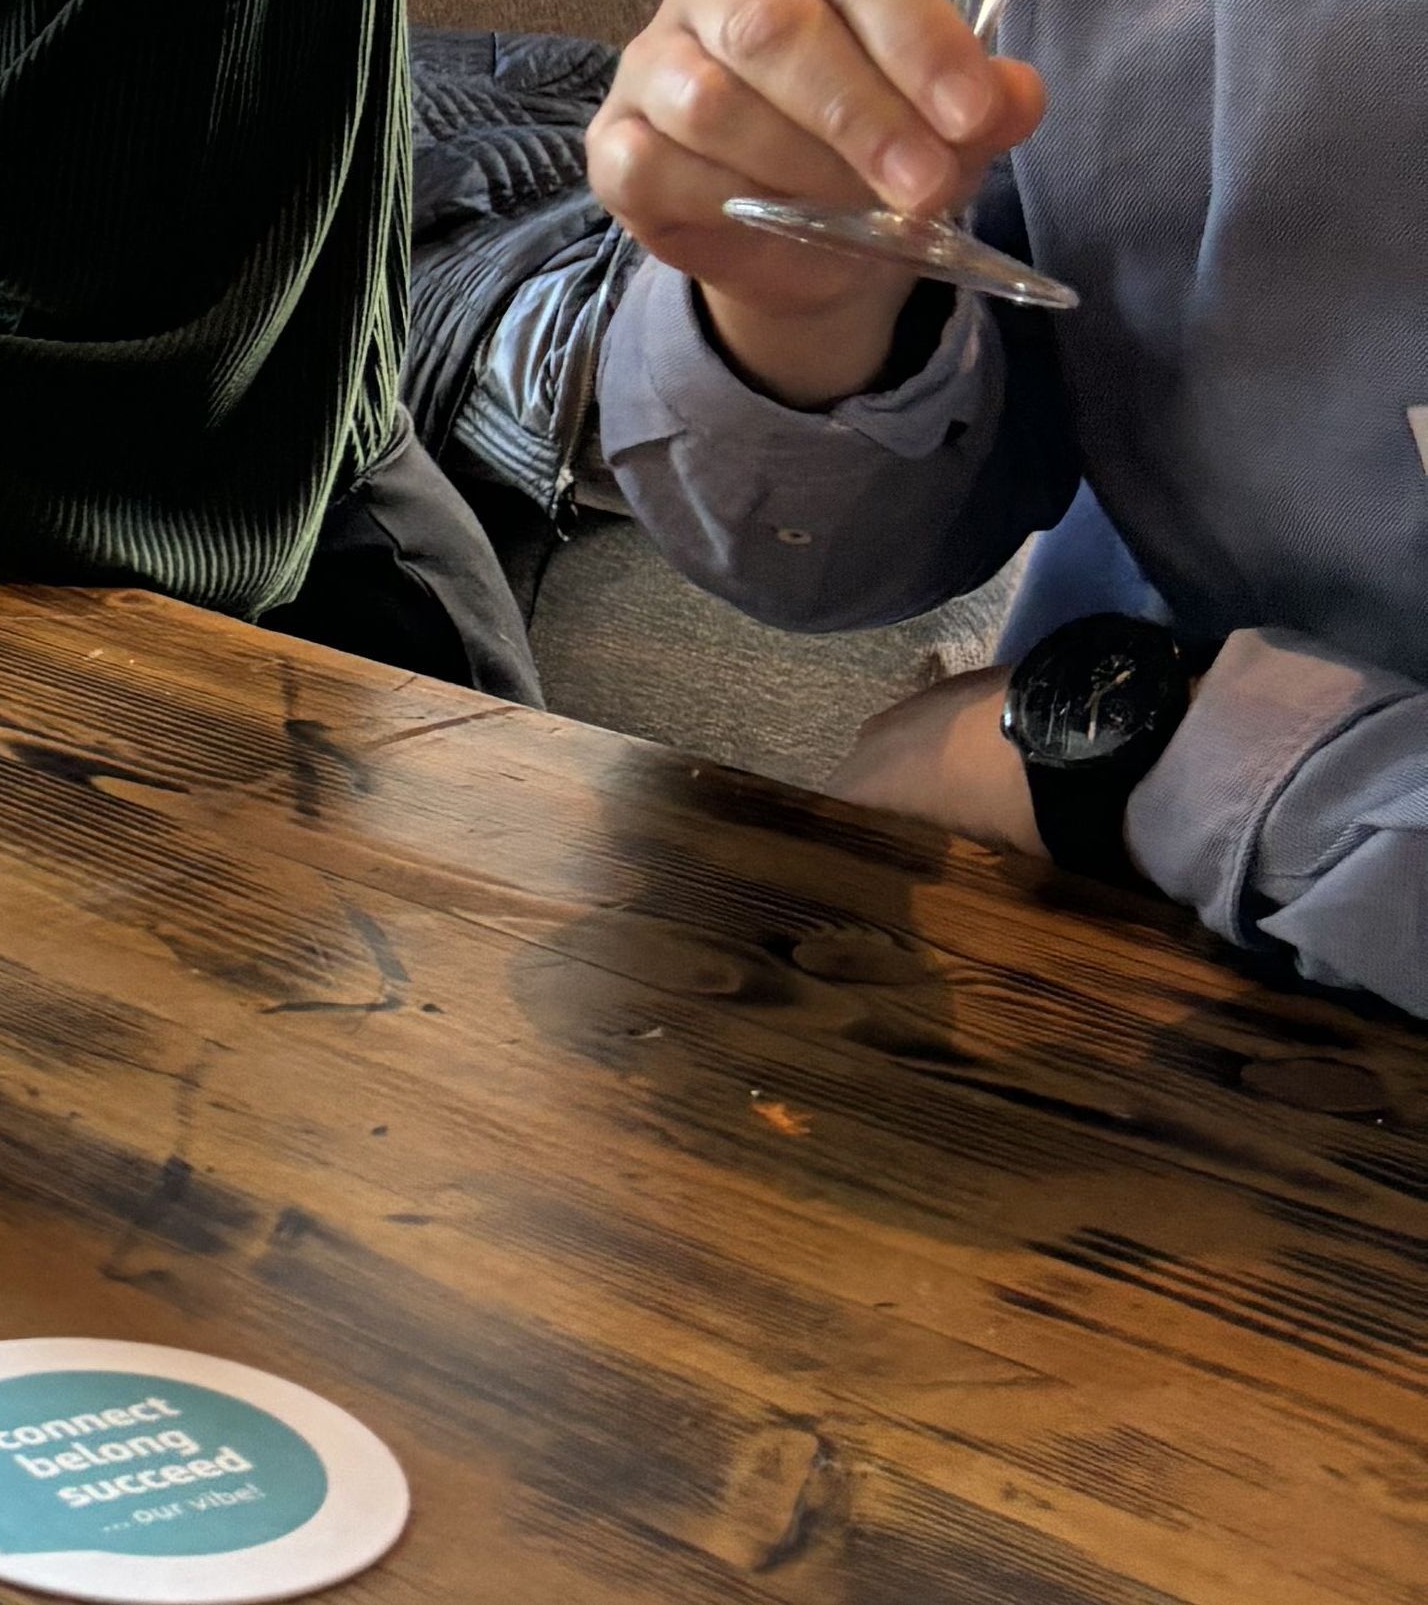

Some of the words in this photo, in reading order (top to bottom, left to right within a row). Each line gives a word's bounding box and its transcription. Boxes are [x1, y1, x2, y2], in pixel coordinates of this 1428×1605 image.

[13, 1429, 200, 1479] belong
[56, 1445, 254, 1509] succeed
[187, 1482, 266, 1511] vibe!
